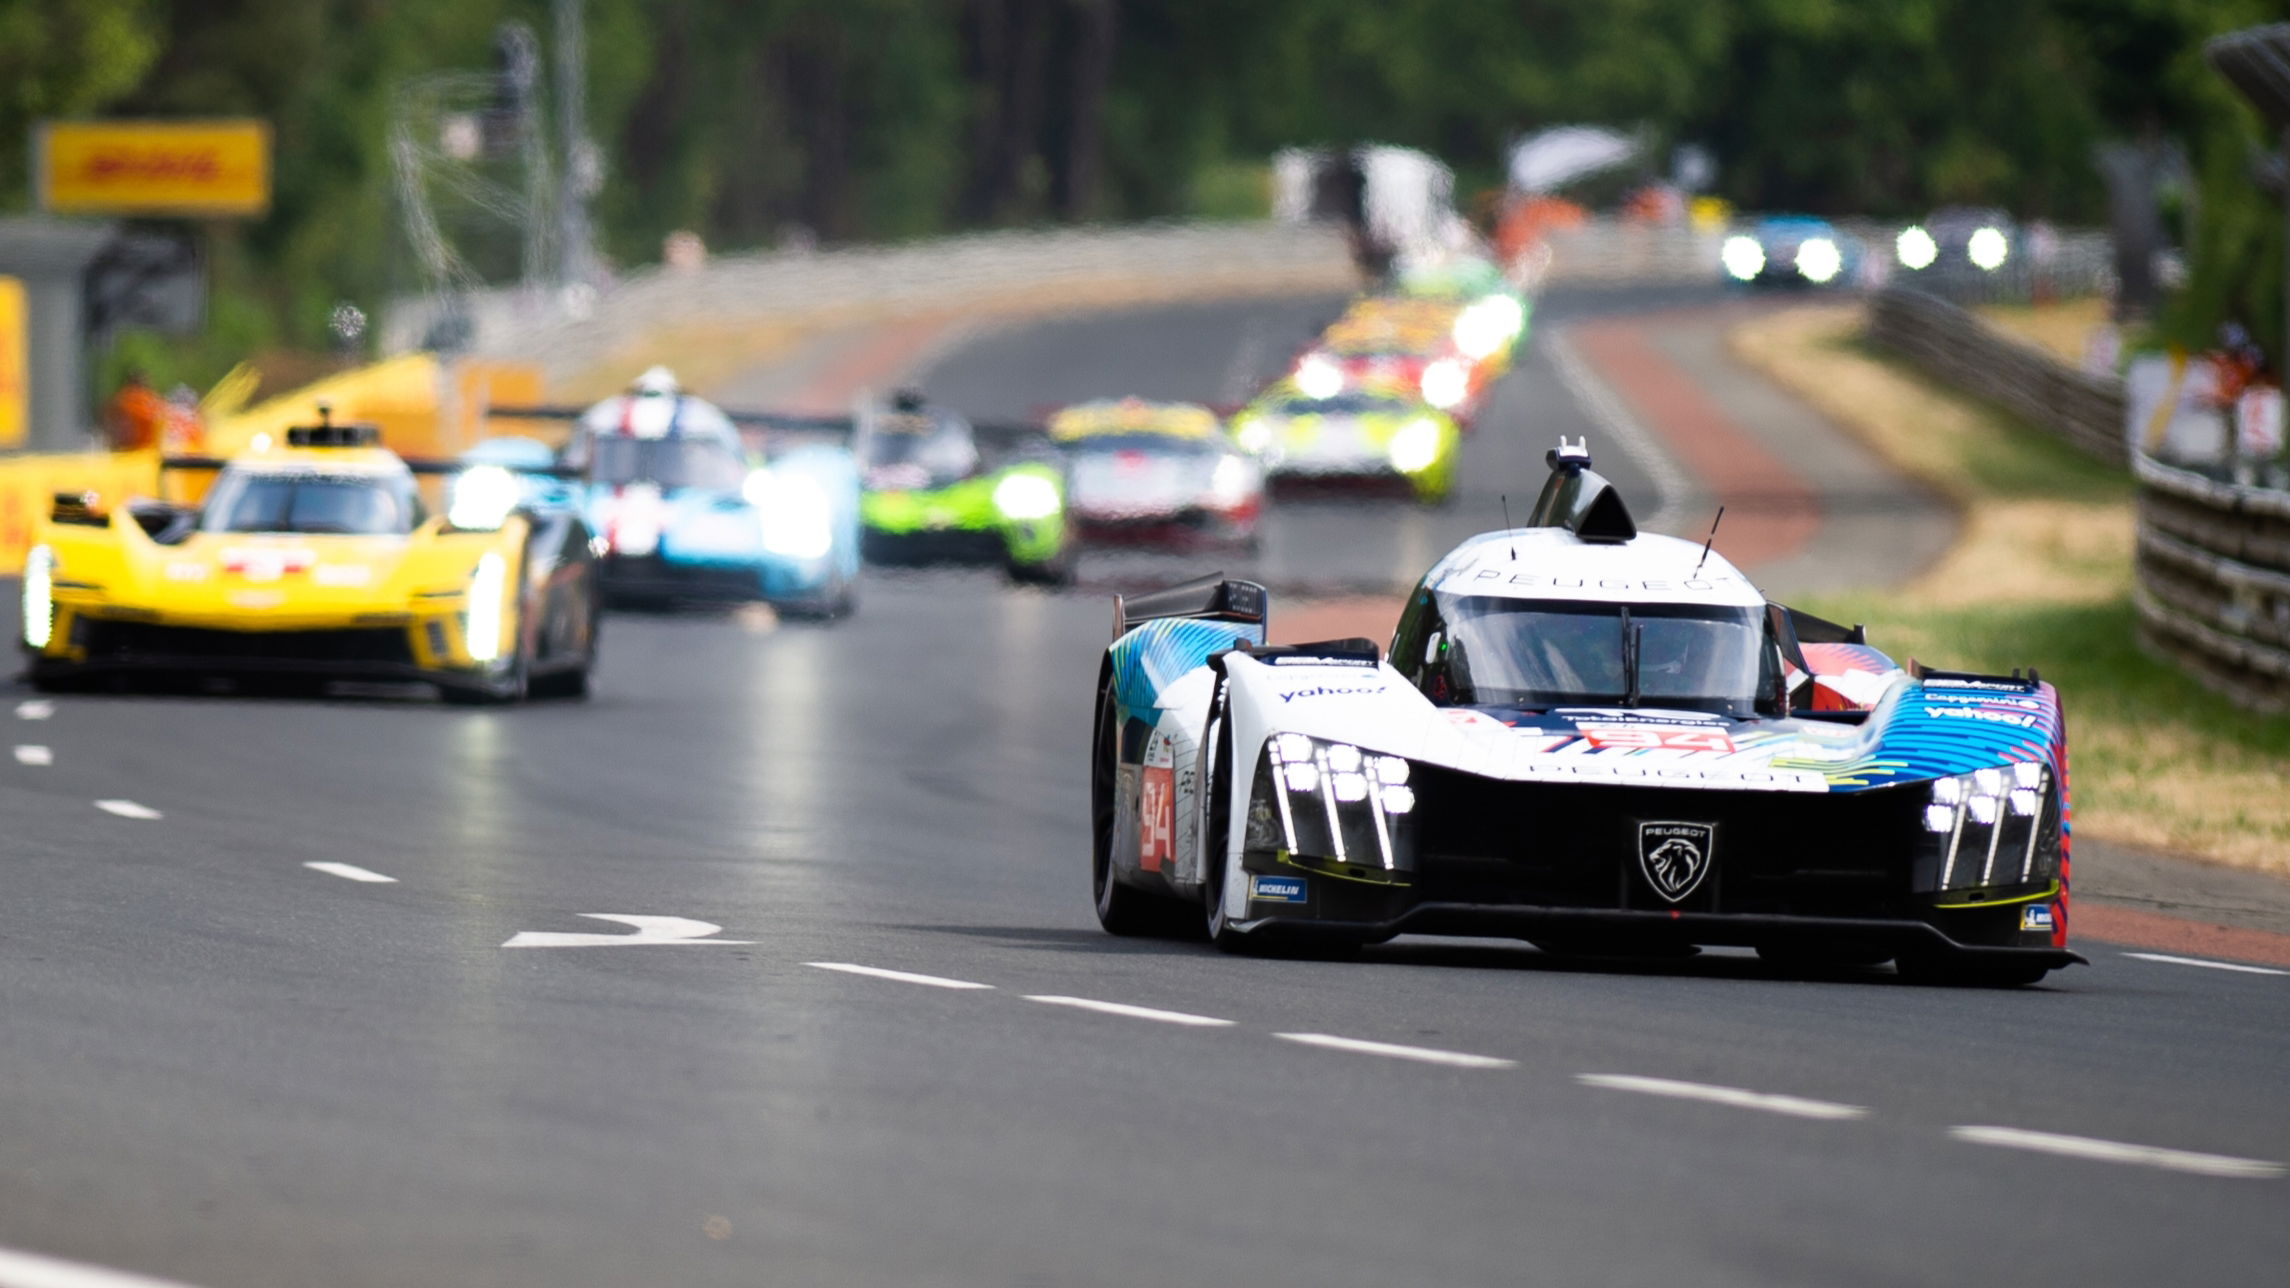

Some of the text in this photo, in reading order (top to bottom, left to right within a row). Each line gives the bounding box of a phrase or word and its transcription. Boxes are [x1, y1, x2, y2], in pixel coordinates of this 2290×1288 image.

[1280, 686, 1387, 703] yahoo!
[1924, 706, 2038, 728] yahoo!
[1588, 729, 1731, 752] 94
[1142, 781, 1172, 859] 94
[1645, 827, 1706, 838] PEUGEOT
[1259, 884, 1300, 896] MICHELIN
